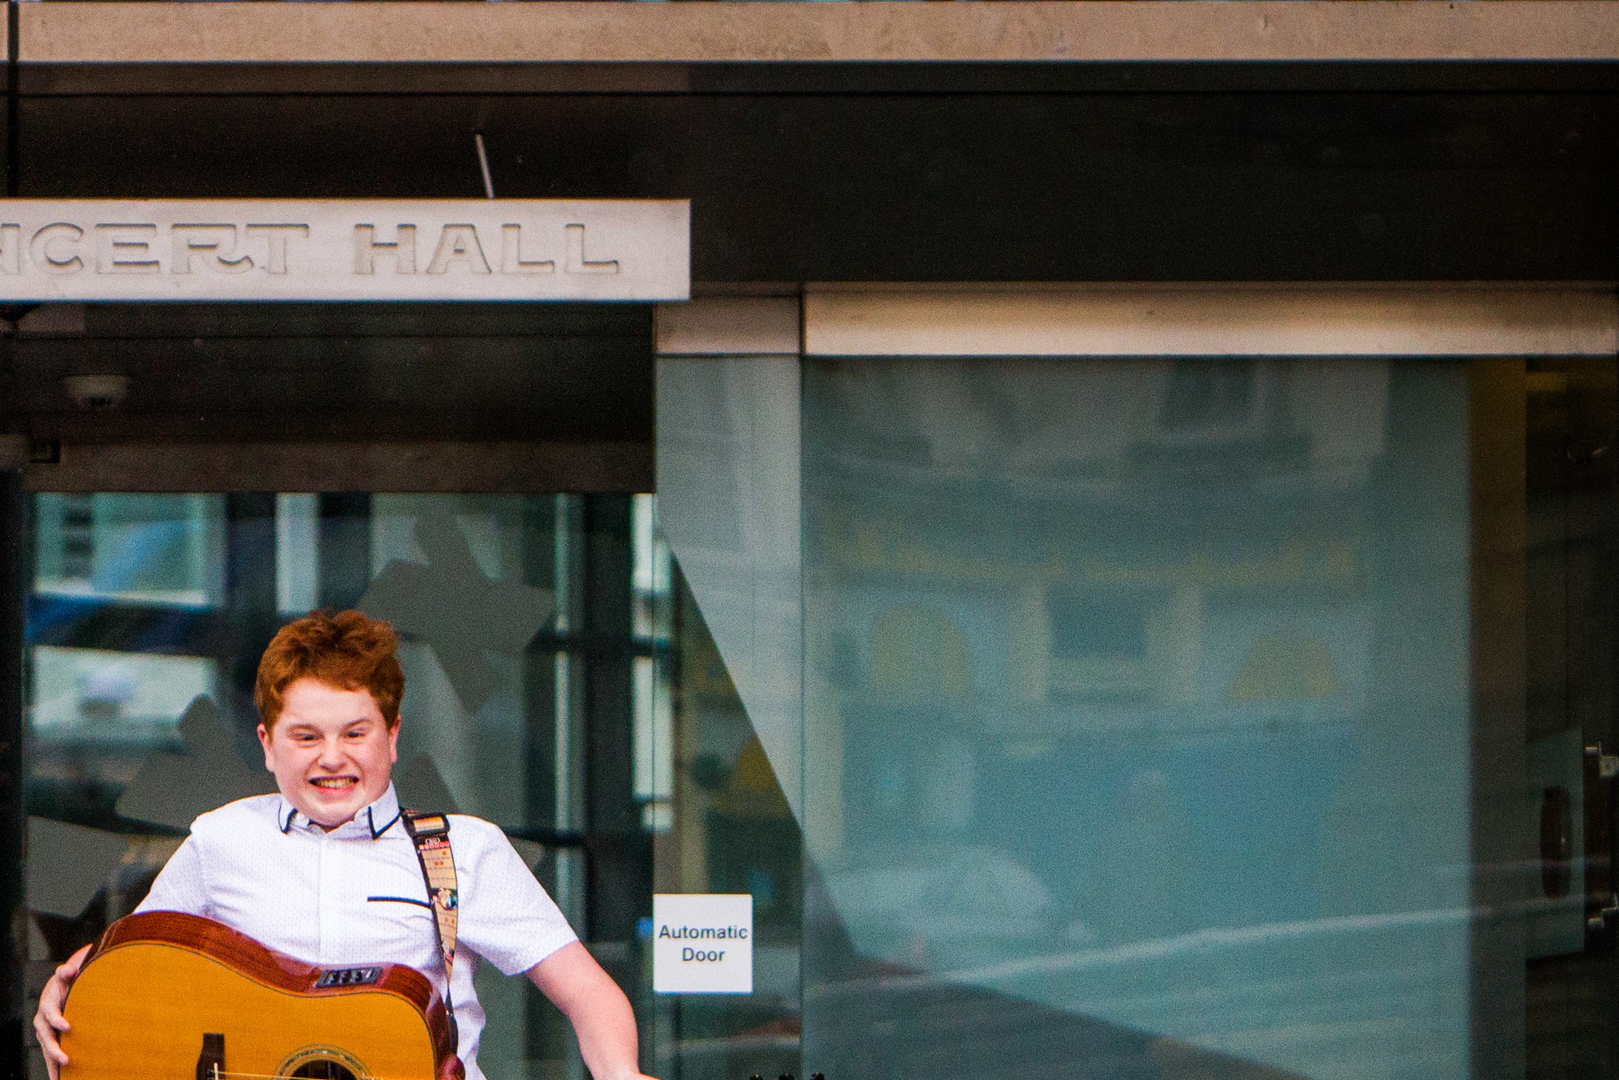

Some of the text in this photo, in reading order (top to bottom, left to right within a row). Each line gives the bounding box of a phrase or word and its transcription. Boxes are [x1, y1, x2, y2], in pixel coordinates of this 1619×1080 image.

[354, 223, 619, 274] HALL
[659, 925, 748, 939] Automatic
[682, 948, 725, 961] Door
